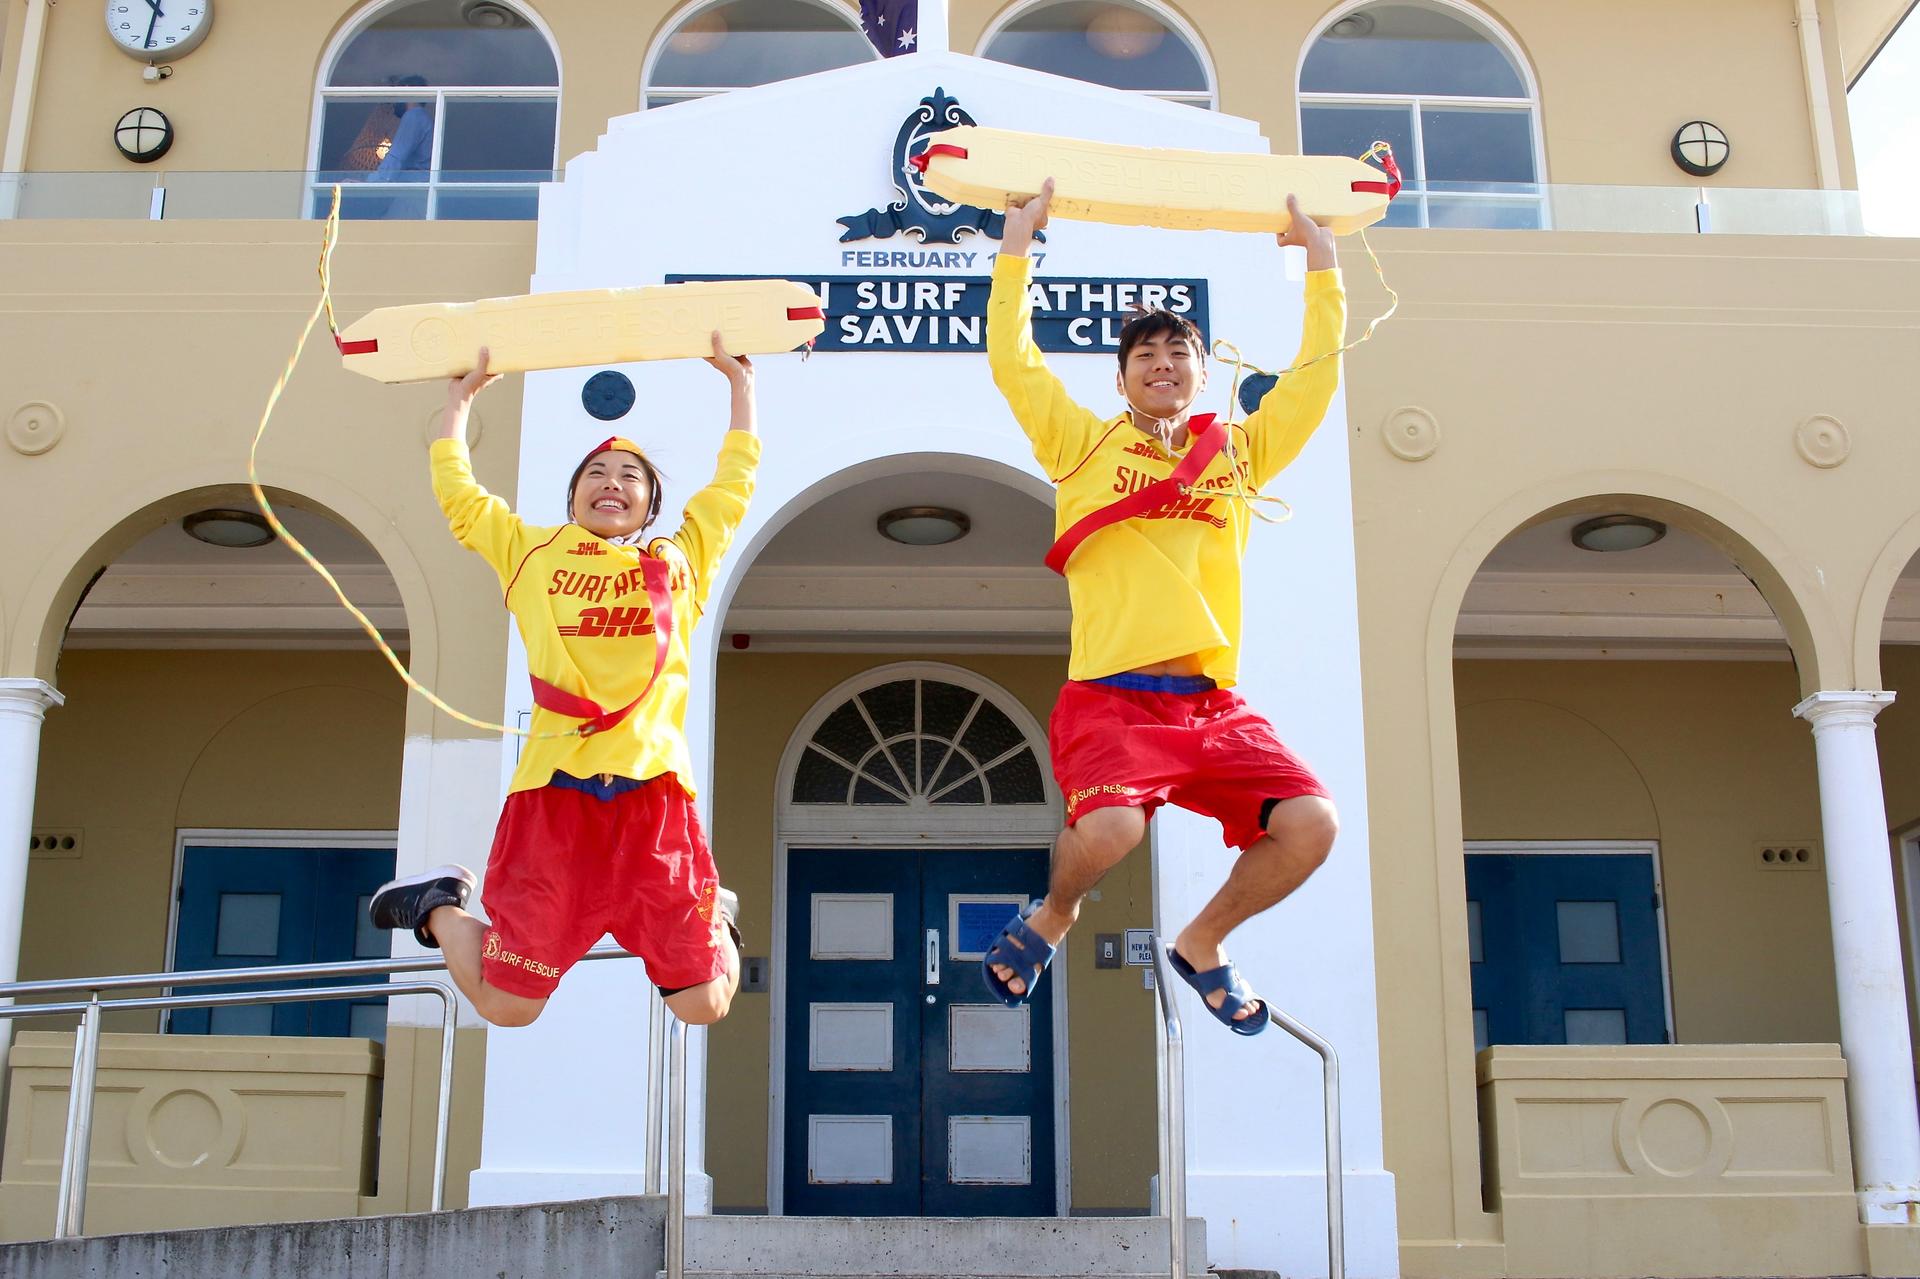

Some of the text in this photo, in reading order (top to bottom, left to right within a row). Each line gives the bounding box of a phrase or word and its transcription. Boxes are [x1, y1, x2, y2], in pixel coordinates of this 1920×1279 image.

[120, 22, 131, 30] 8
[841, 251, 977, 269] FEBRUARY
[856, 281, 966, 311] SURF
[1027, 283, 1192, 313] ATHERS
[488, 304, 746, 350] SURF RESCUE
[840, 315, 1121, 347] SAVIN CL
[571, 542, 605, 556] DHL
[548, 569, 613, 603] SURF
[576, 607, 657, 637] DHL
[1078, 785, 1101, 801] SURF
[500, 950, 560, 978] SURF RESCUE
[1139, 952, 1152, 961] PLEA
